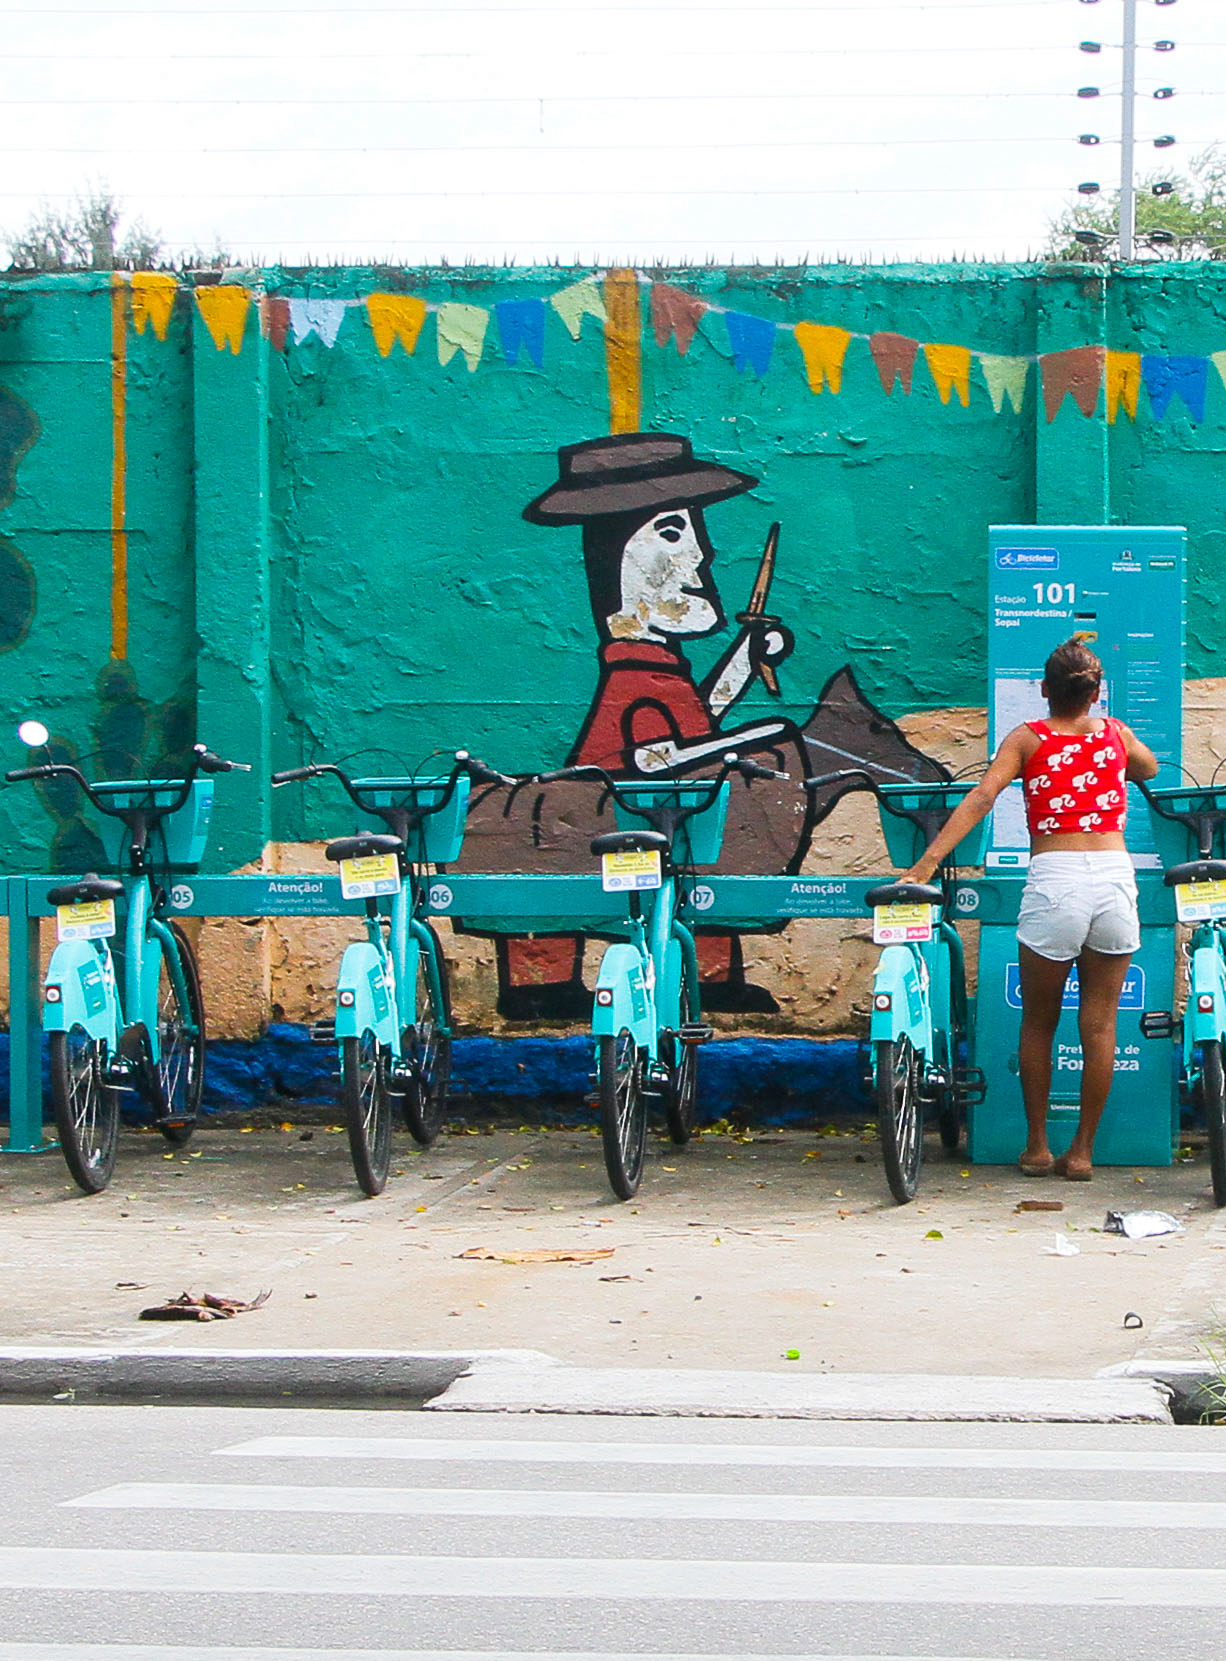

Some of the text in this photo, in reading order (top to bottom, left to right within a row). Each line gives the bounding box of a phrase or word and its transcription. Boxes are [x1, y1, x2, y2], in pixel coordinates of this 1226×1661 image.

[994, 582, 1075, 604] Estação 101
[994, 608, 1067, 618] Transnordestina
[268, 882, 324, 894] Atenção!
[791, 883, 846, 896] Atenção!
[173, 890, 191, 903] 05
[430, 890, 450, 902] 06
[957, 893, 977, 906] 08
[1124, 1044, 1140, 1054] de
